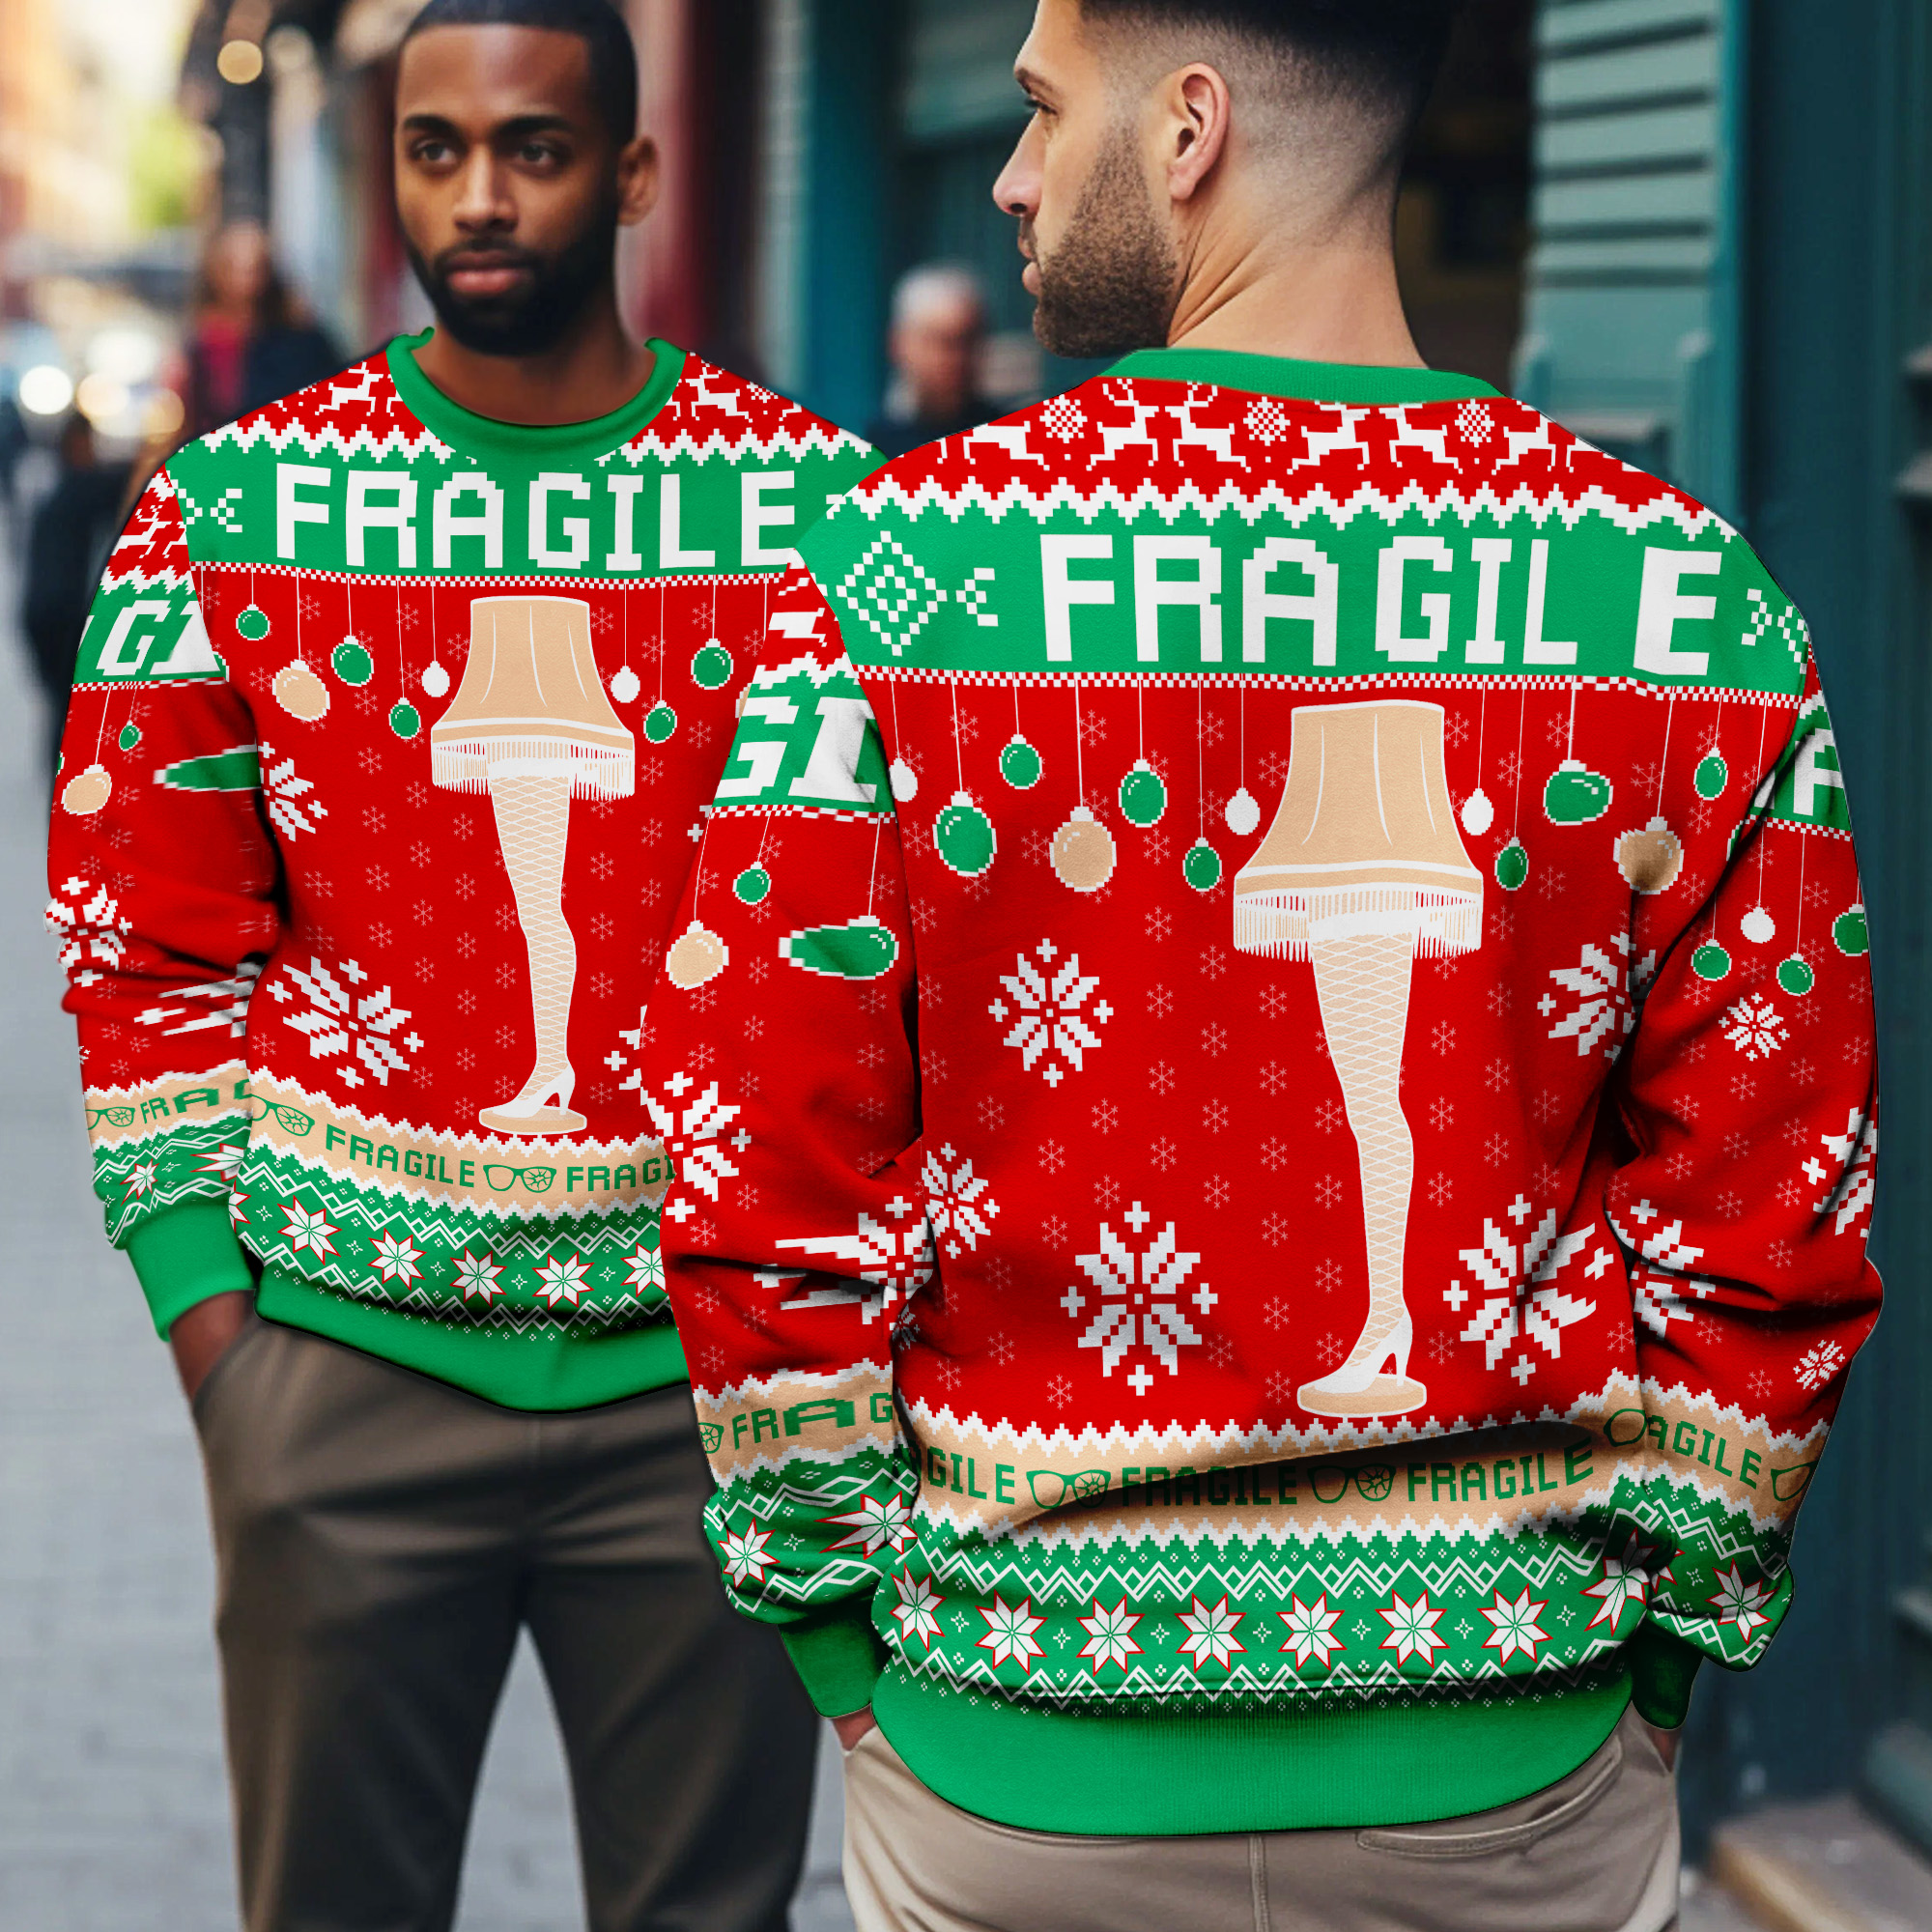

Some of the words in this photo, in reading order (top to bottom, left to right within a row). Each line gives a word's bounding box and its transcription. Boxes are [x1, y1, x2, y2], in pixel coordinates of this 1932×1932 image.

[276, 463, 796, 571] FRAGILE
[77, 600, 220, 675] GI
[1039, 534, 1721, 675] FRAGILE
[326, 1123, 474, 1188] FRAGILE
[732, 1392, 893, 1450] FRAG
[1122, 1465, 1297, 1507] FRAGILE
[1406, 1435, 1594, 1502] FRAGILE
